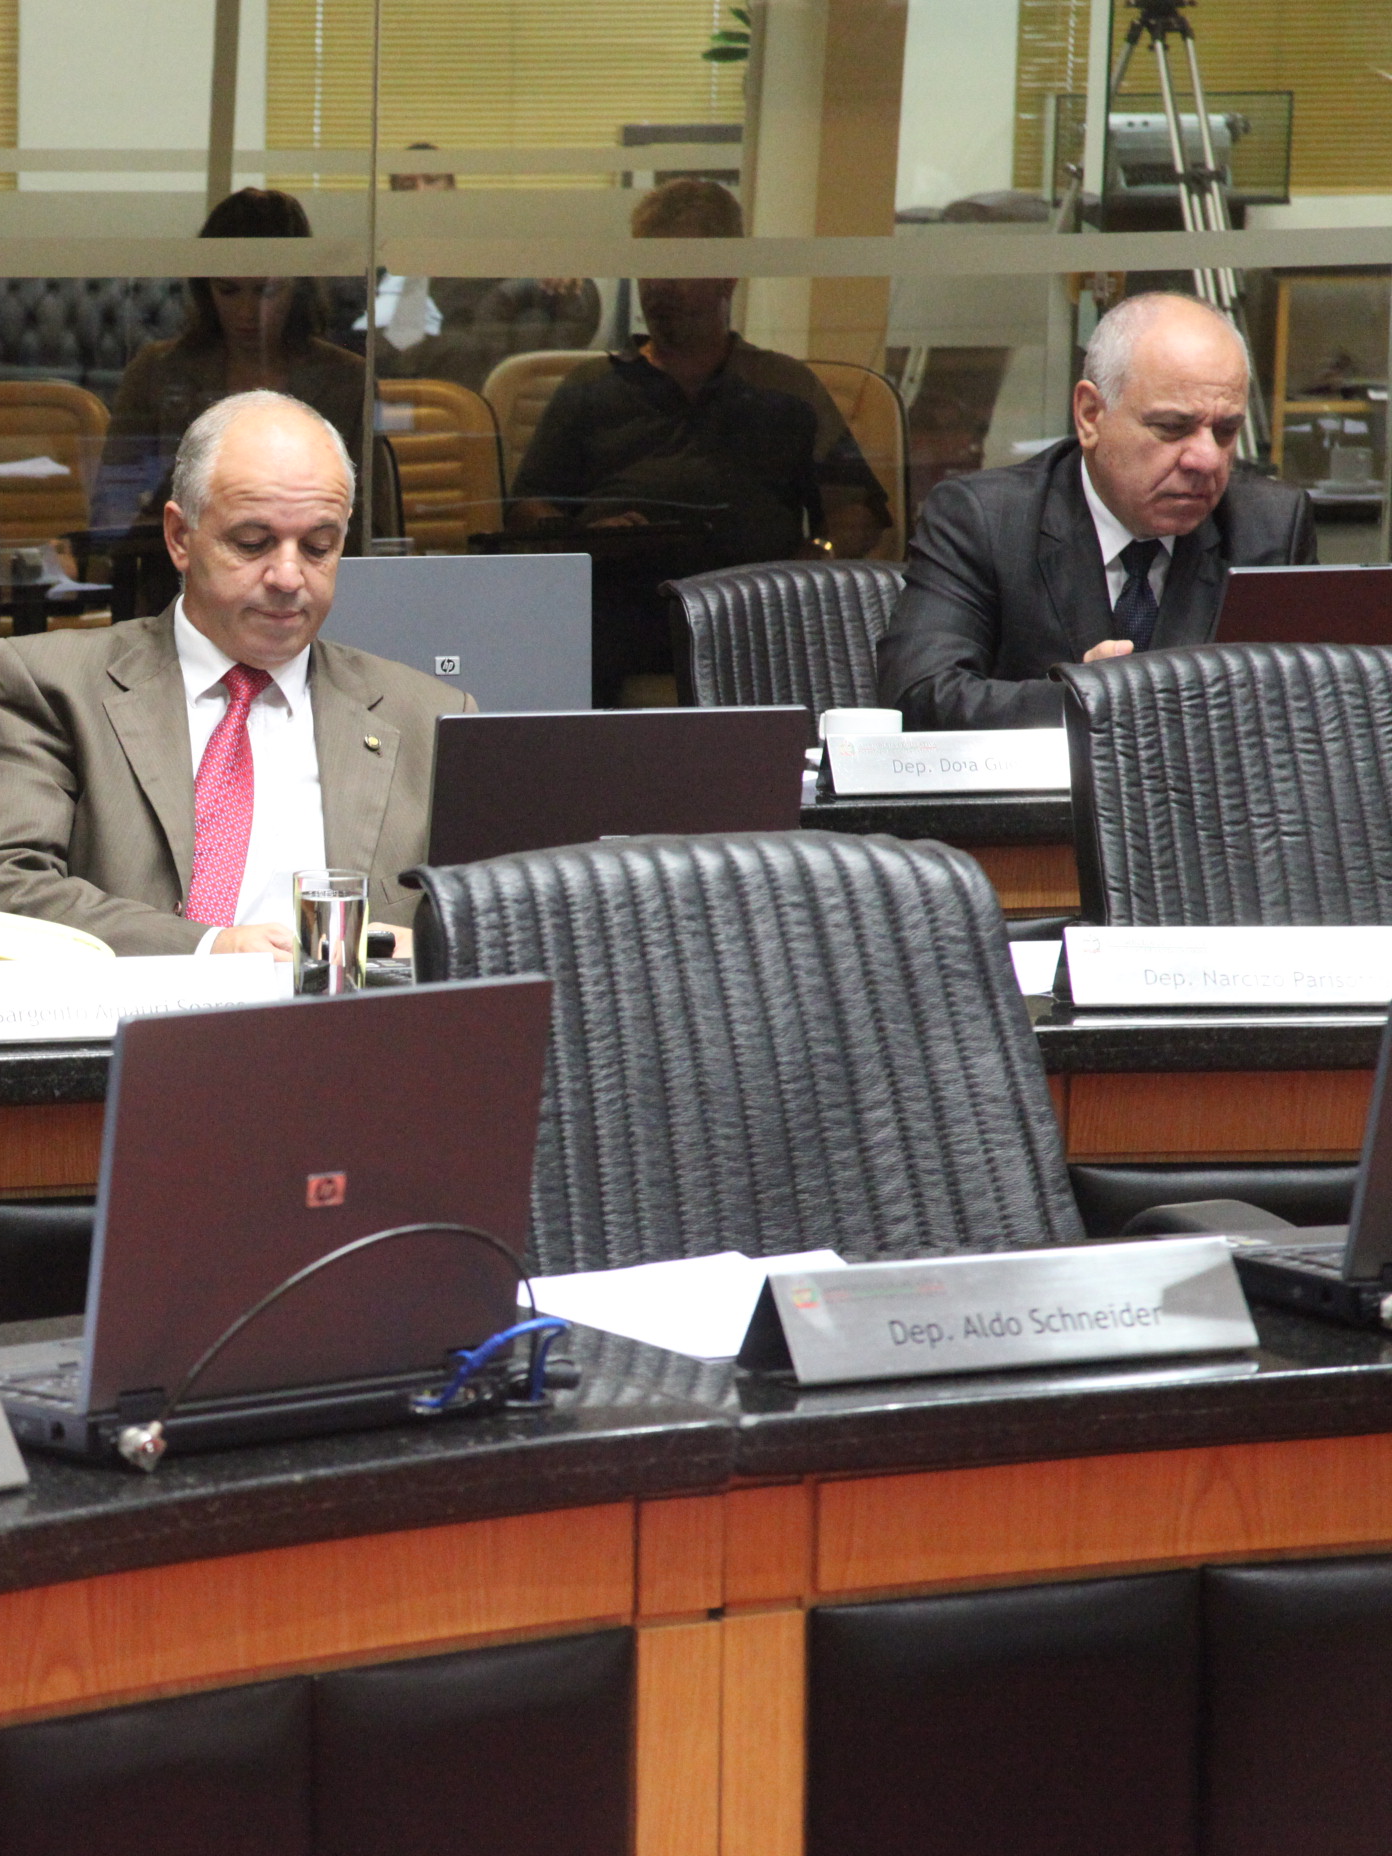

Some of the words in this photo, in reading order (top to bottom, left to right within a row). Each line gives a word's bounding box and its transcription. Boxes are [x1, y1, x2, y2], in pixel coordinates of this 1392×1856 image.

[892, 758, 932, 776] Dep.
[1144, 969, 1192, 990] Dep.
[1203, 970, 1284, 988] Narcizo
[888, 1319, 954, 1348] Dep.
[963, 1306, 1021, 1340] Aldo
[1031, 1302, 1163, 1335] Schneider
